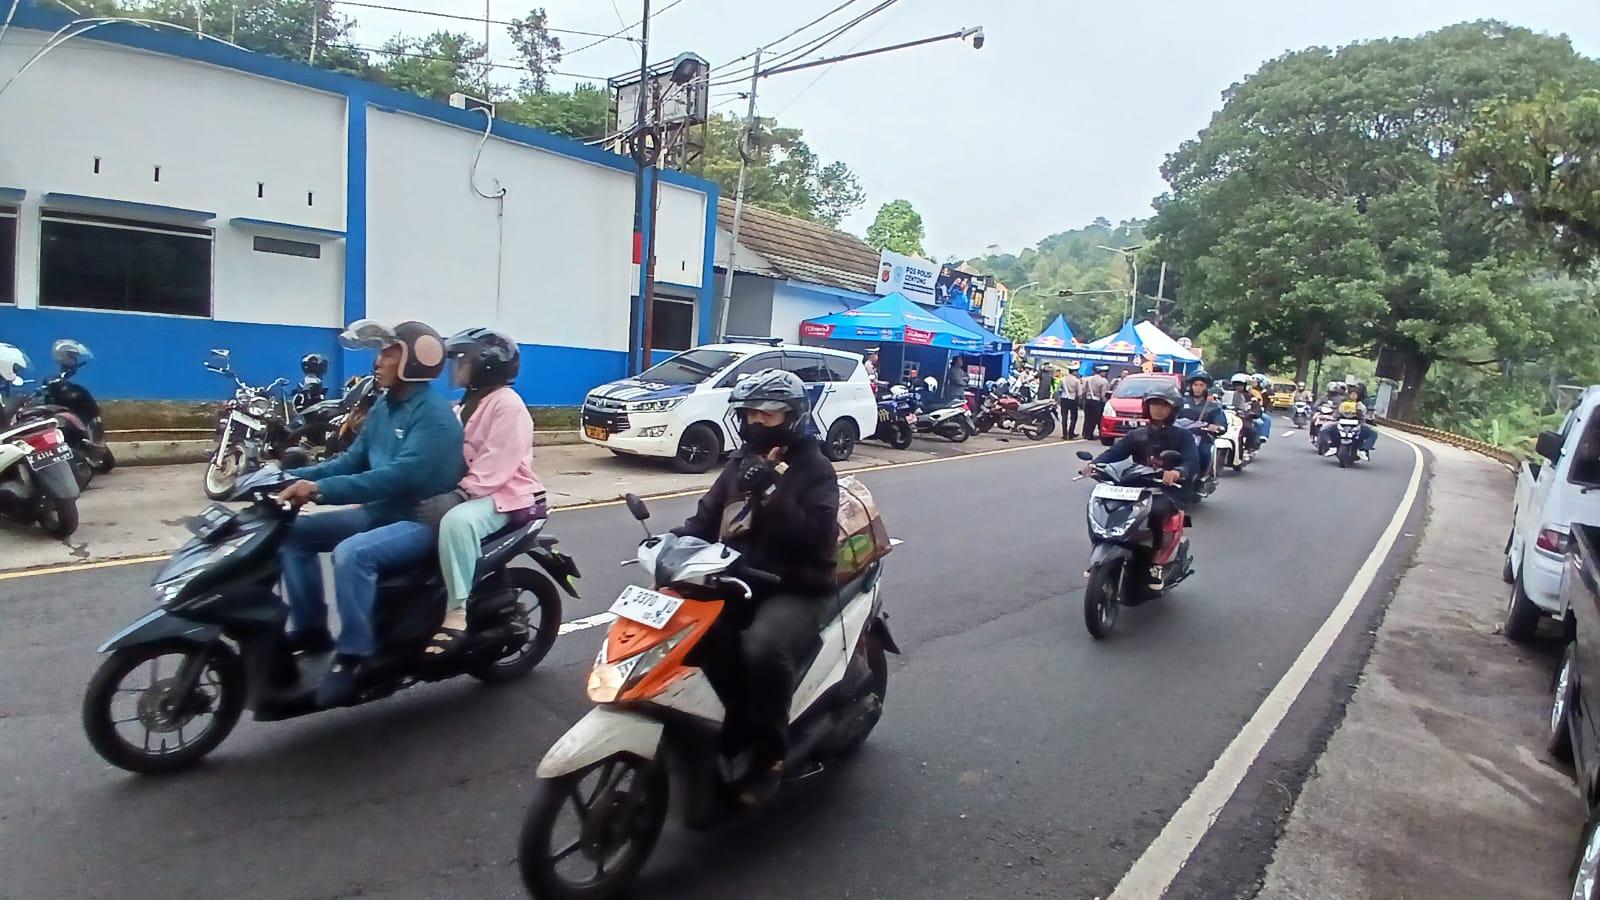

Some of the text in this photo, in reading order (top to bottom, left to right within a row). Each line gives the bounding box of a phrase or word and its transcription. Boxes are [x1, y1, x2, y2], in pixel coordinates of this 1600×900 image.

[906, 266, 932, 278] POS POLISI
[633, 591, 659, 607] 3370
